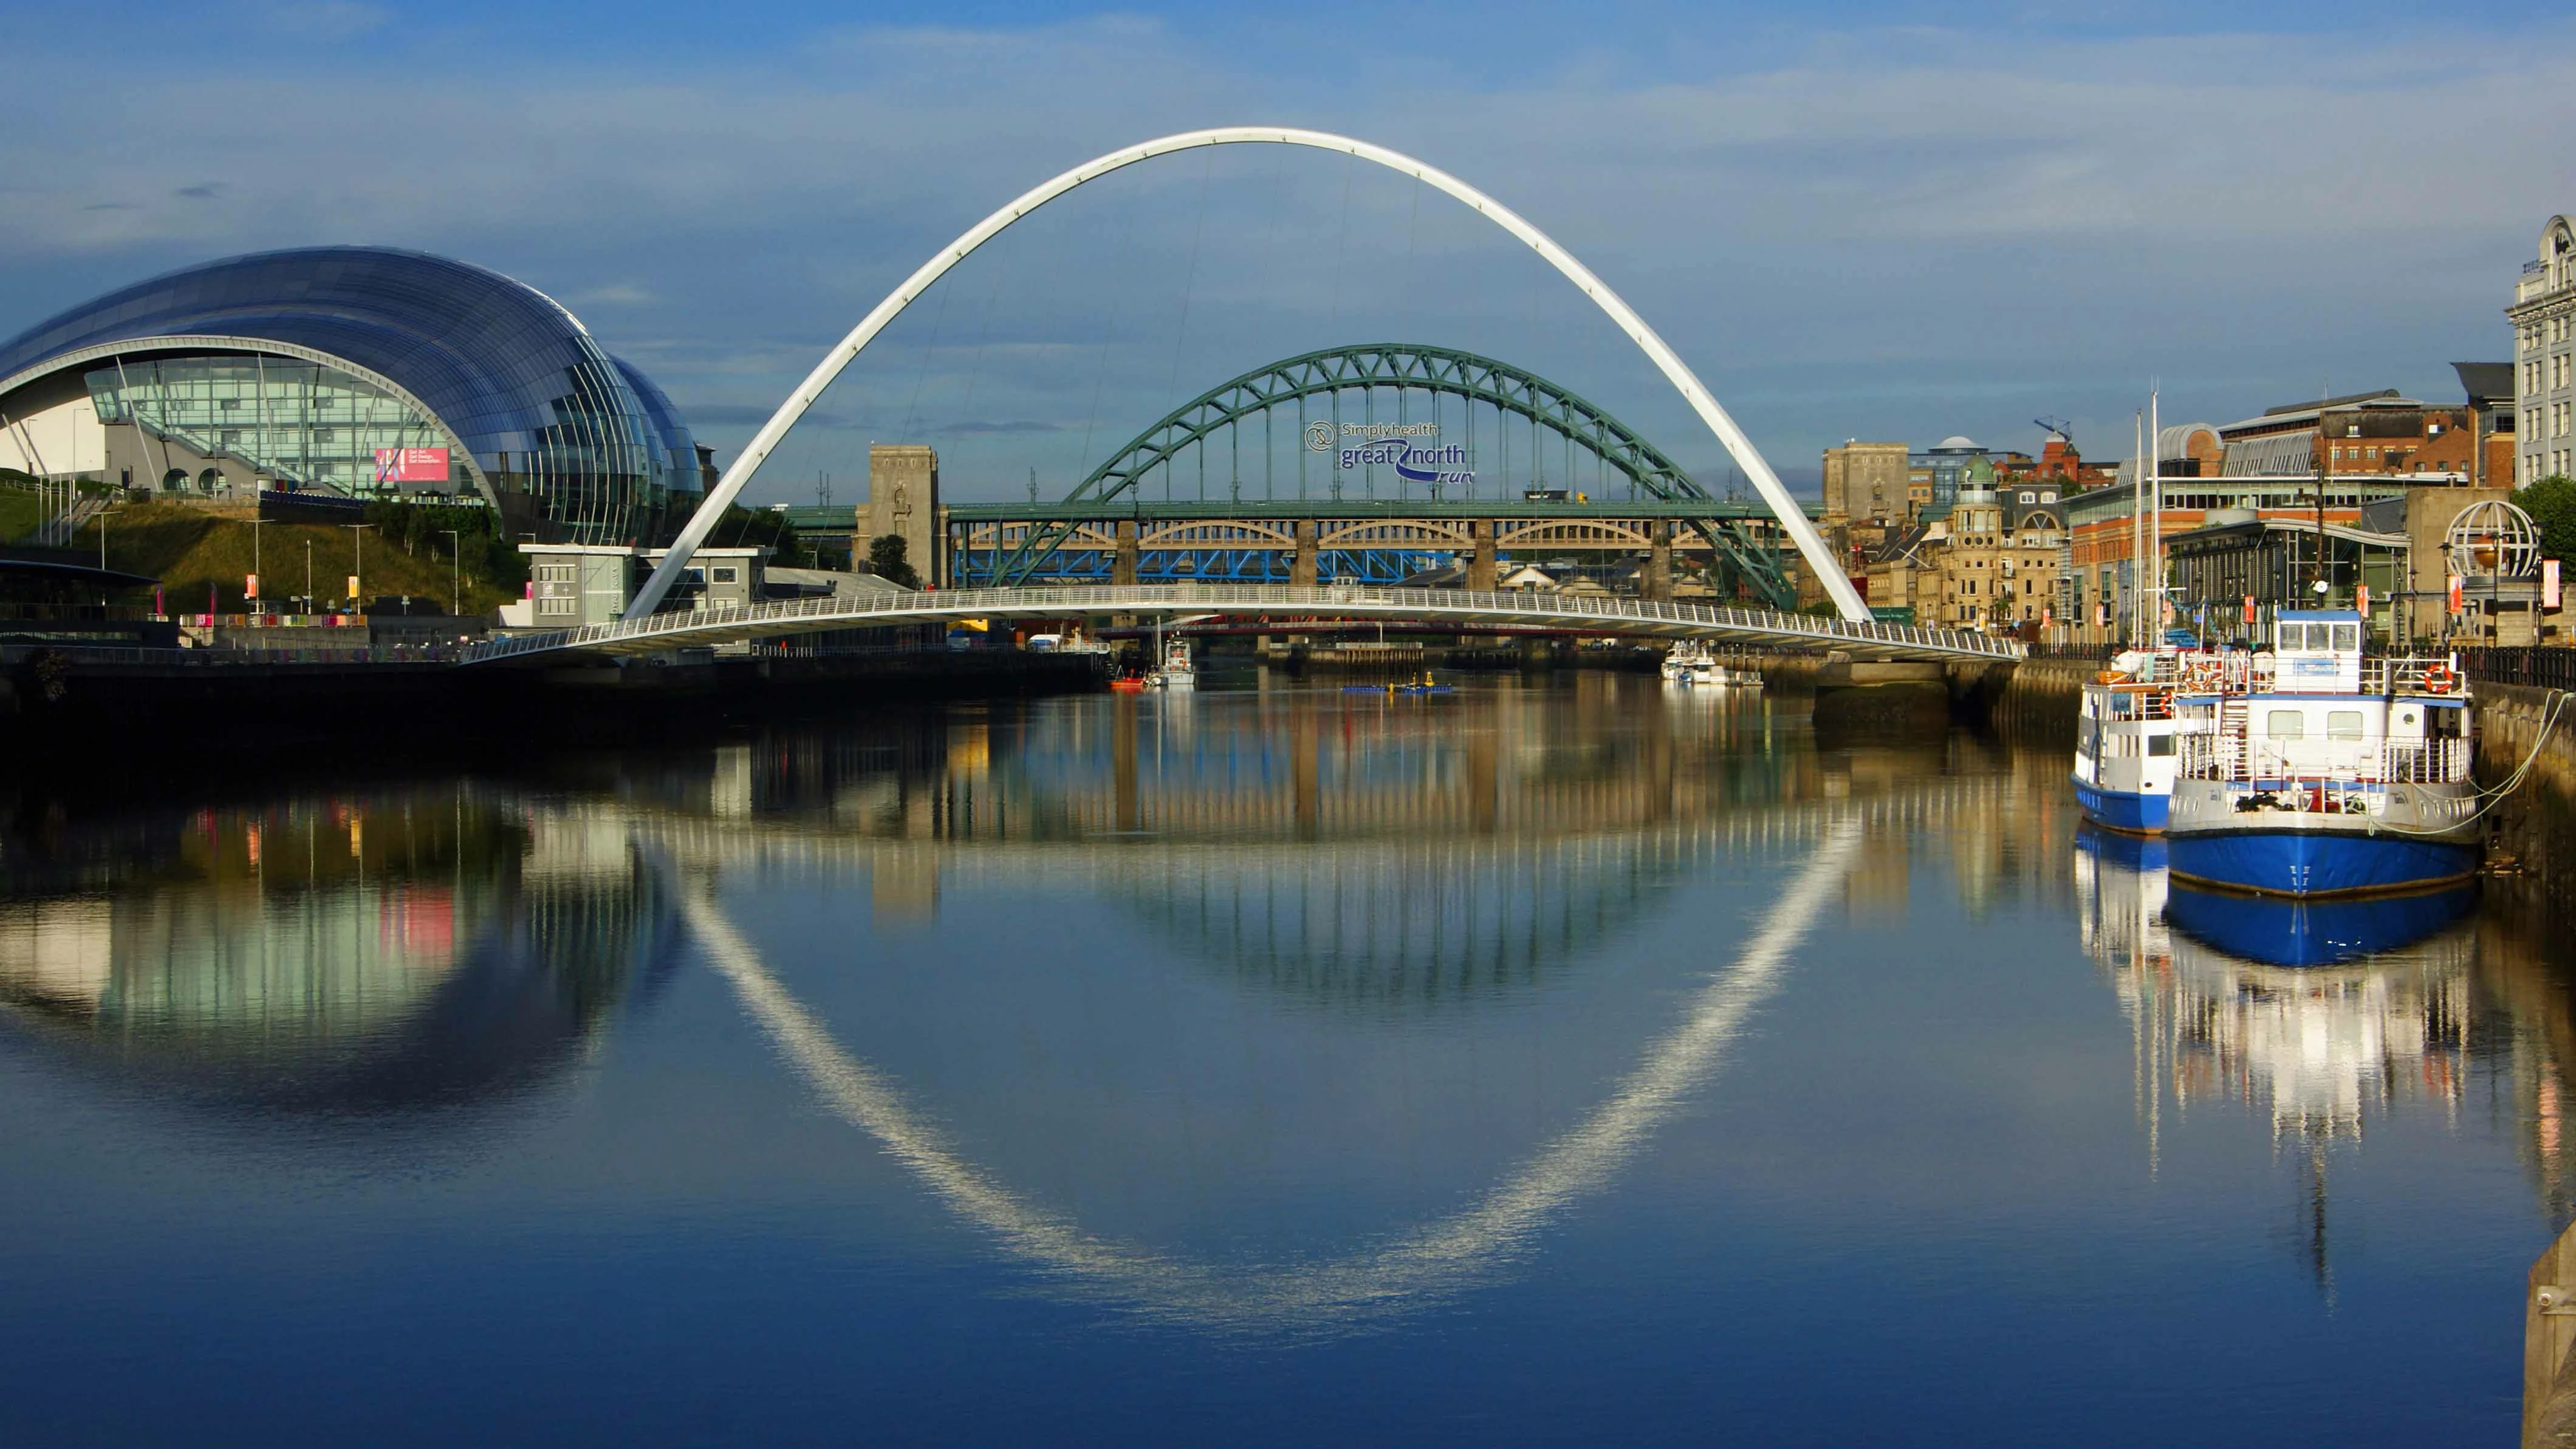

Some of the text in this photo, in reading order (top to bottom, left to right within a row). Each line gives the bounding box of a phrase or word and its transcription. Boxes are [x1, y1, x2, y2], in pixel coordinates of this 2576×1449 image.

[1341, 423, 1438, 439] Simplyhealth
[1341, 444, 1465, 469] great north
[1437, 470, 1473, 484] run
